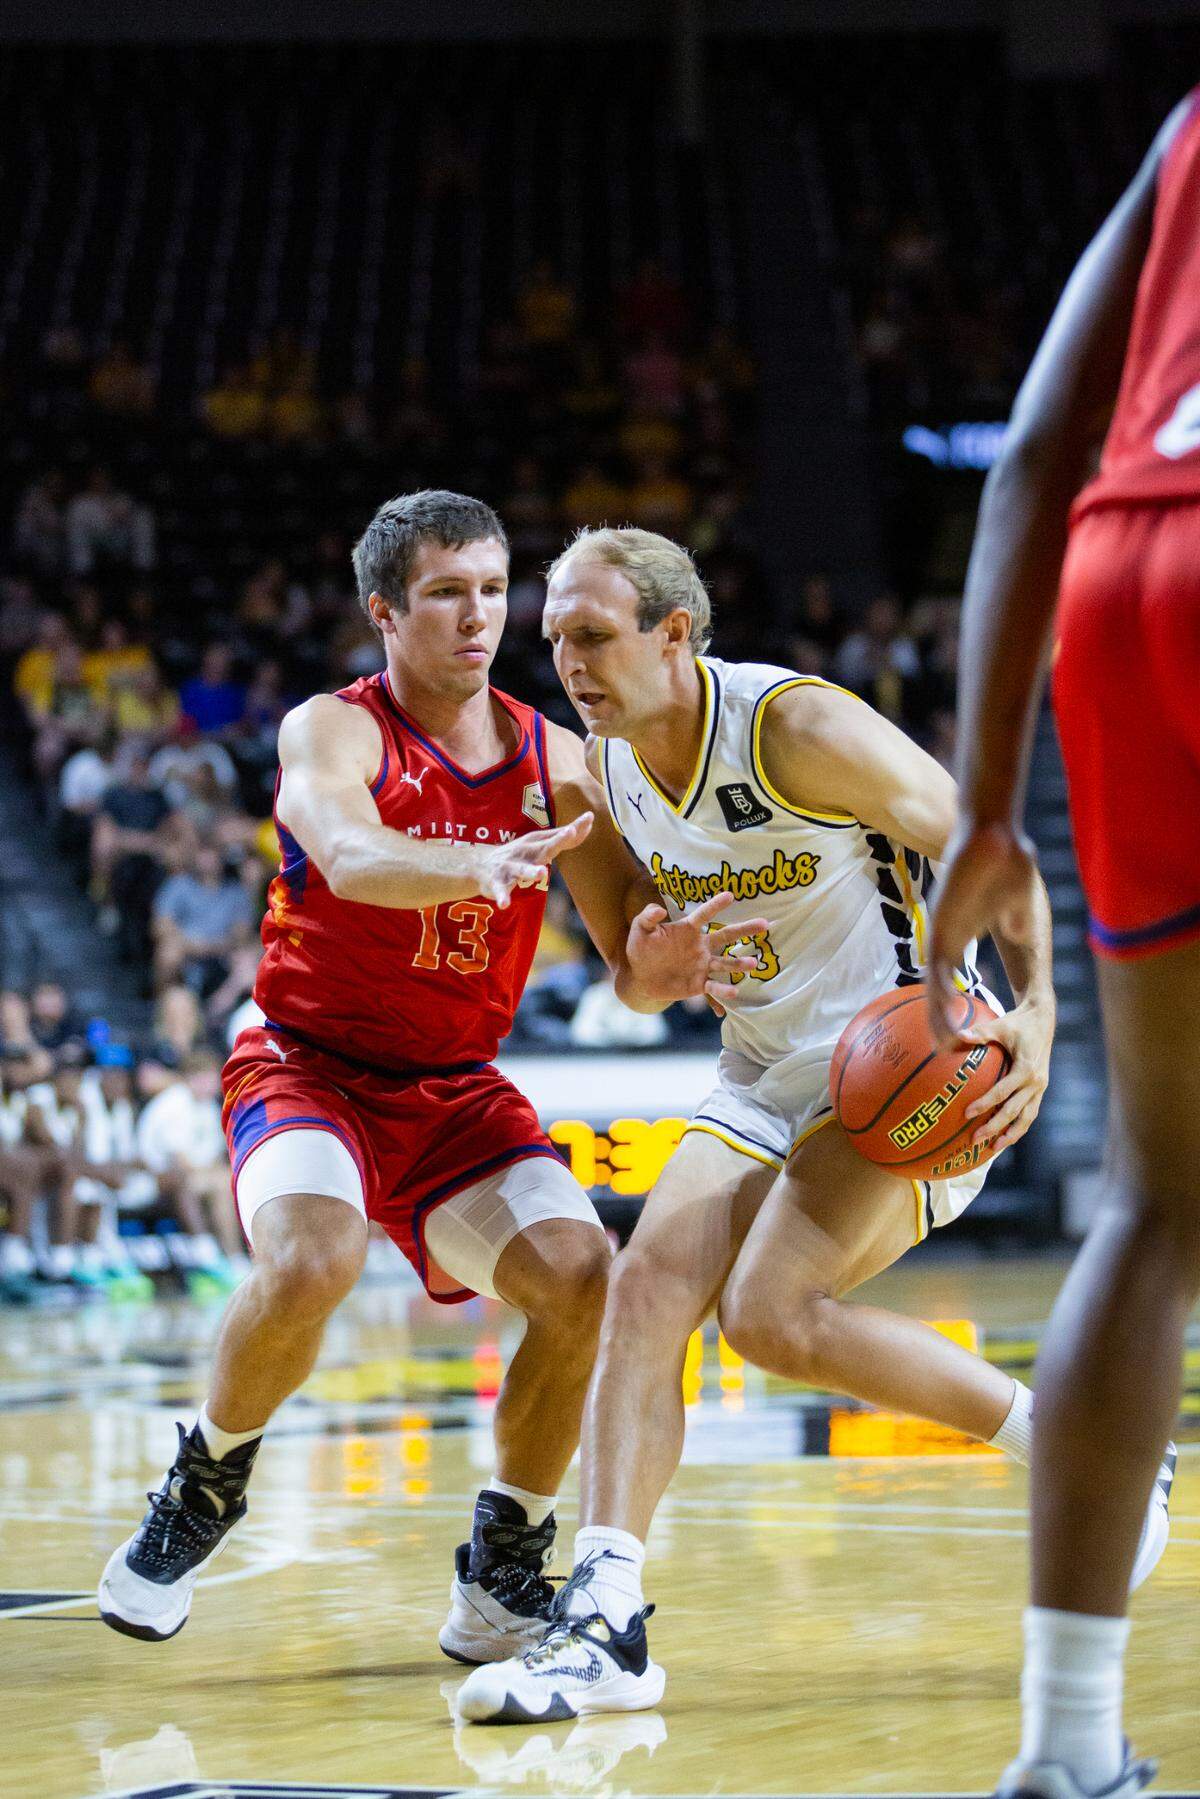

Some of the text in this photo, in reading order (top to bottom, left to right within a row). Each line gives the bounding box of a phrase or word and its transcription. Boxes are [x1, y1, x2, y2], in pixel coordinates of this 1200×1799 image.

[407, 821, 516, 844] MIDTOW
[734, 811, 766, 828] POLLUX
[651, 849, 821, 911] Aftershocks
[411, 901, 494, 974] 13
[924, 1043, 989, 1121] ELITE
[890, 1109, 933, 1149] PRO
